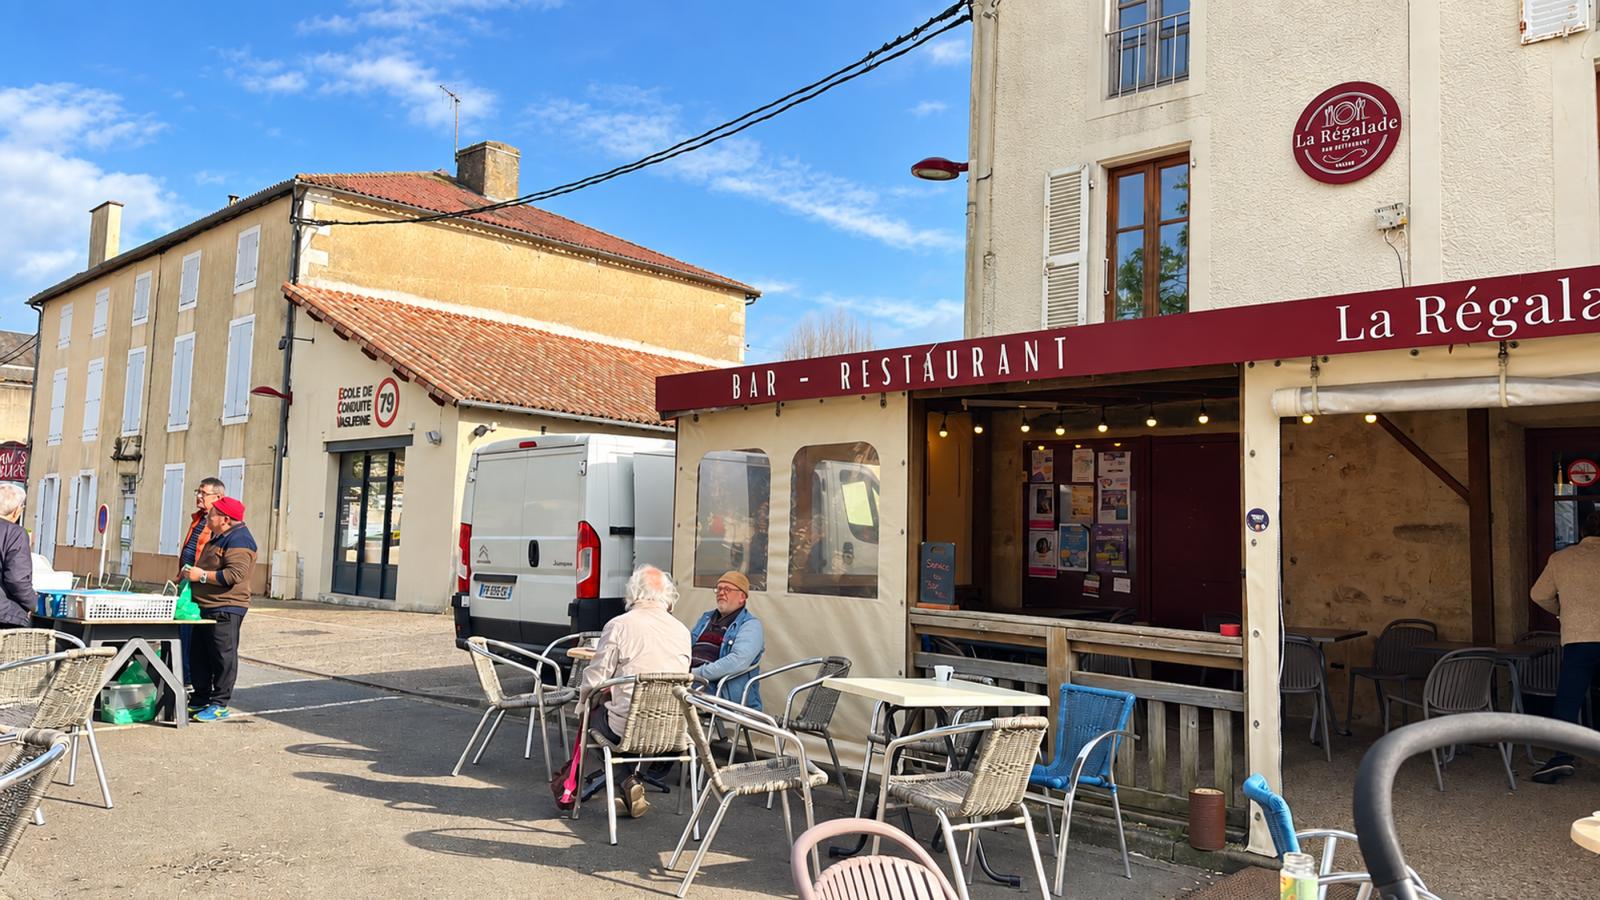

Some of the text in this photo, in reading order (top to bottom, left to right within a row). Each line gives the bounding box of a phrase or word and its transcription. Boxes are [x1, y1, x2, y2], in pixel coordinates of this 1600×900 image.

[1296, 116, 1398, 148] La Régalade
[1336, 305, 1395, 342] La
[733, 371, 776, 400] BAR
[841, 336, 1066, 390] RESTAURANT
[362, 385, 373, 397] DE
[380, 392, 395, 413] 79
[337, 400, 372, 414] CONDUITE
